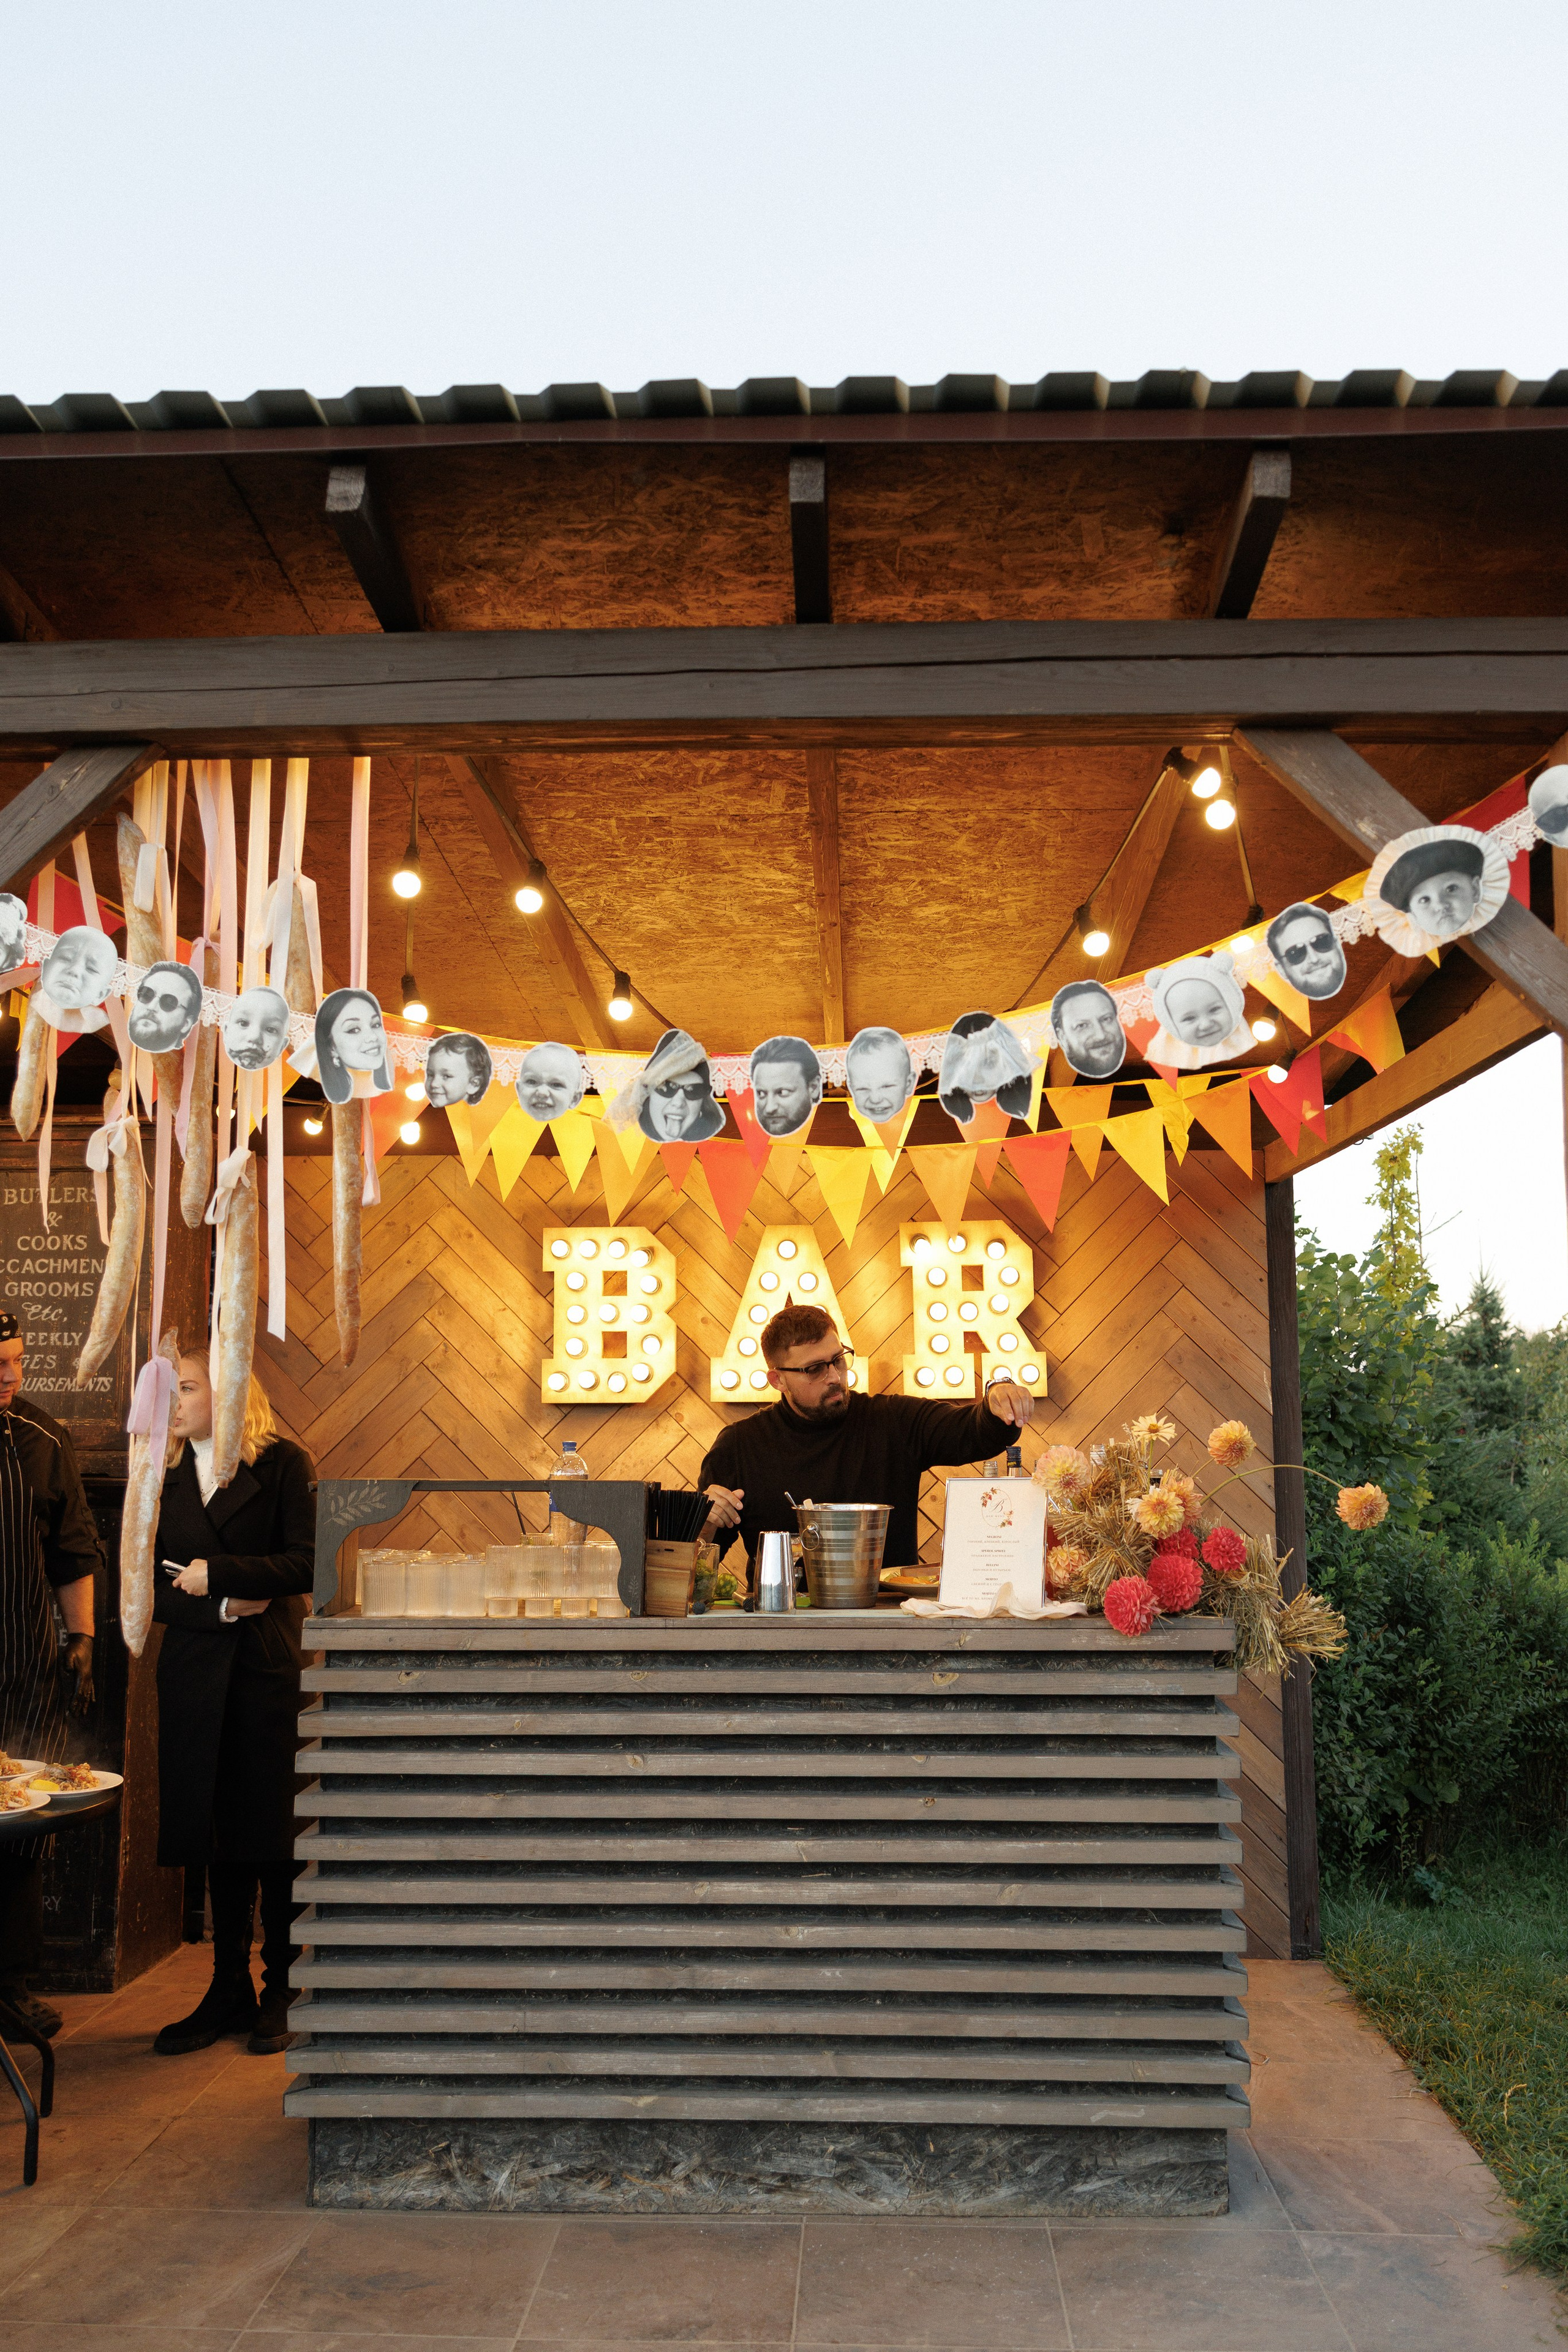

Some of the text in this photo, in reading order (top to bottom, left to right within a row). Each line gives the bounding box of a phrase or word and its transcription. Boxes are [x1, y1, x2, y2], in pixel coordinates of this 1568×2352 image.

[17, 1234, 88, 1251] COOKS
[4, 1281, 94, 1297] GROOMS
[541, 1220, 1048, 1403] BAR
[21, 1332, 83, 1346] EEKLY
[21, 1354, 57, 1369] GES
